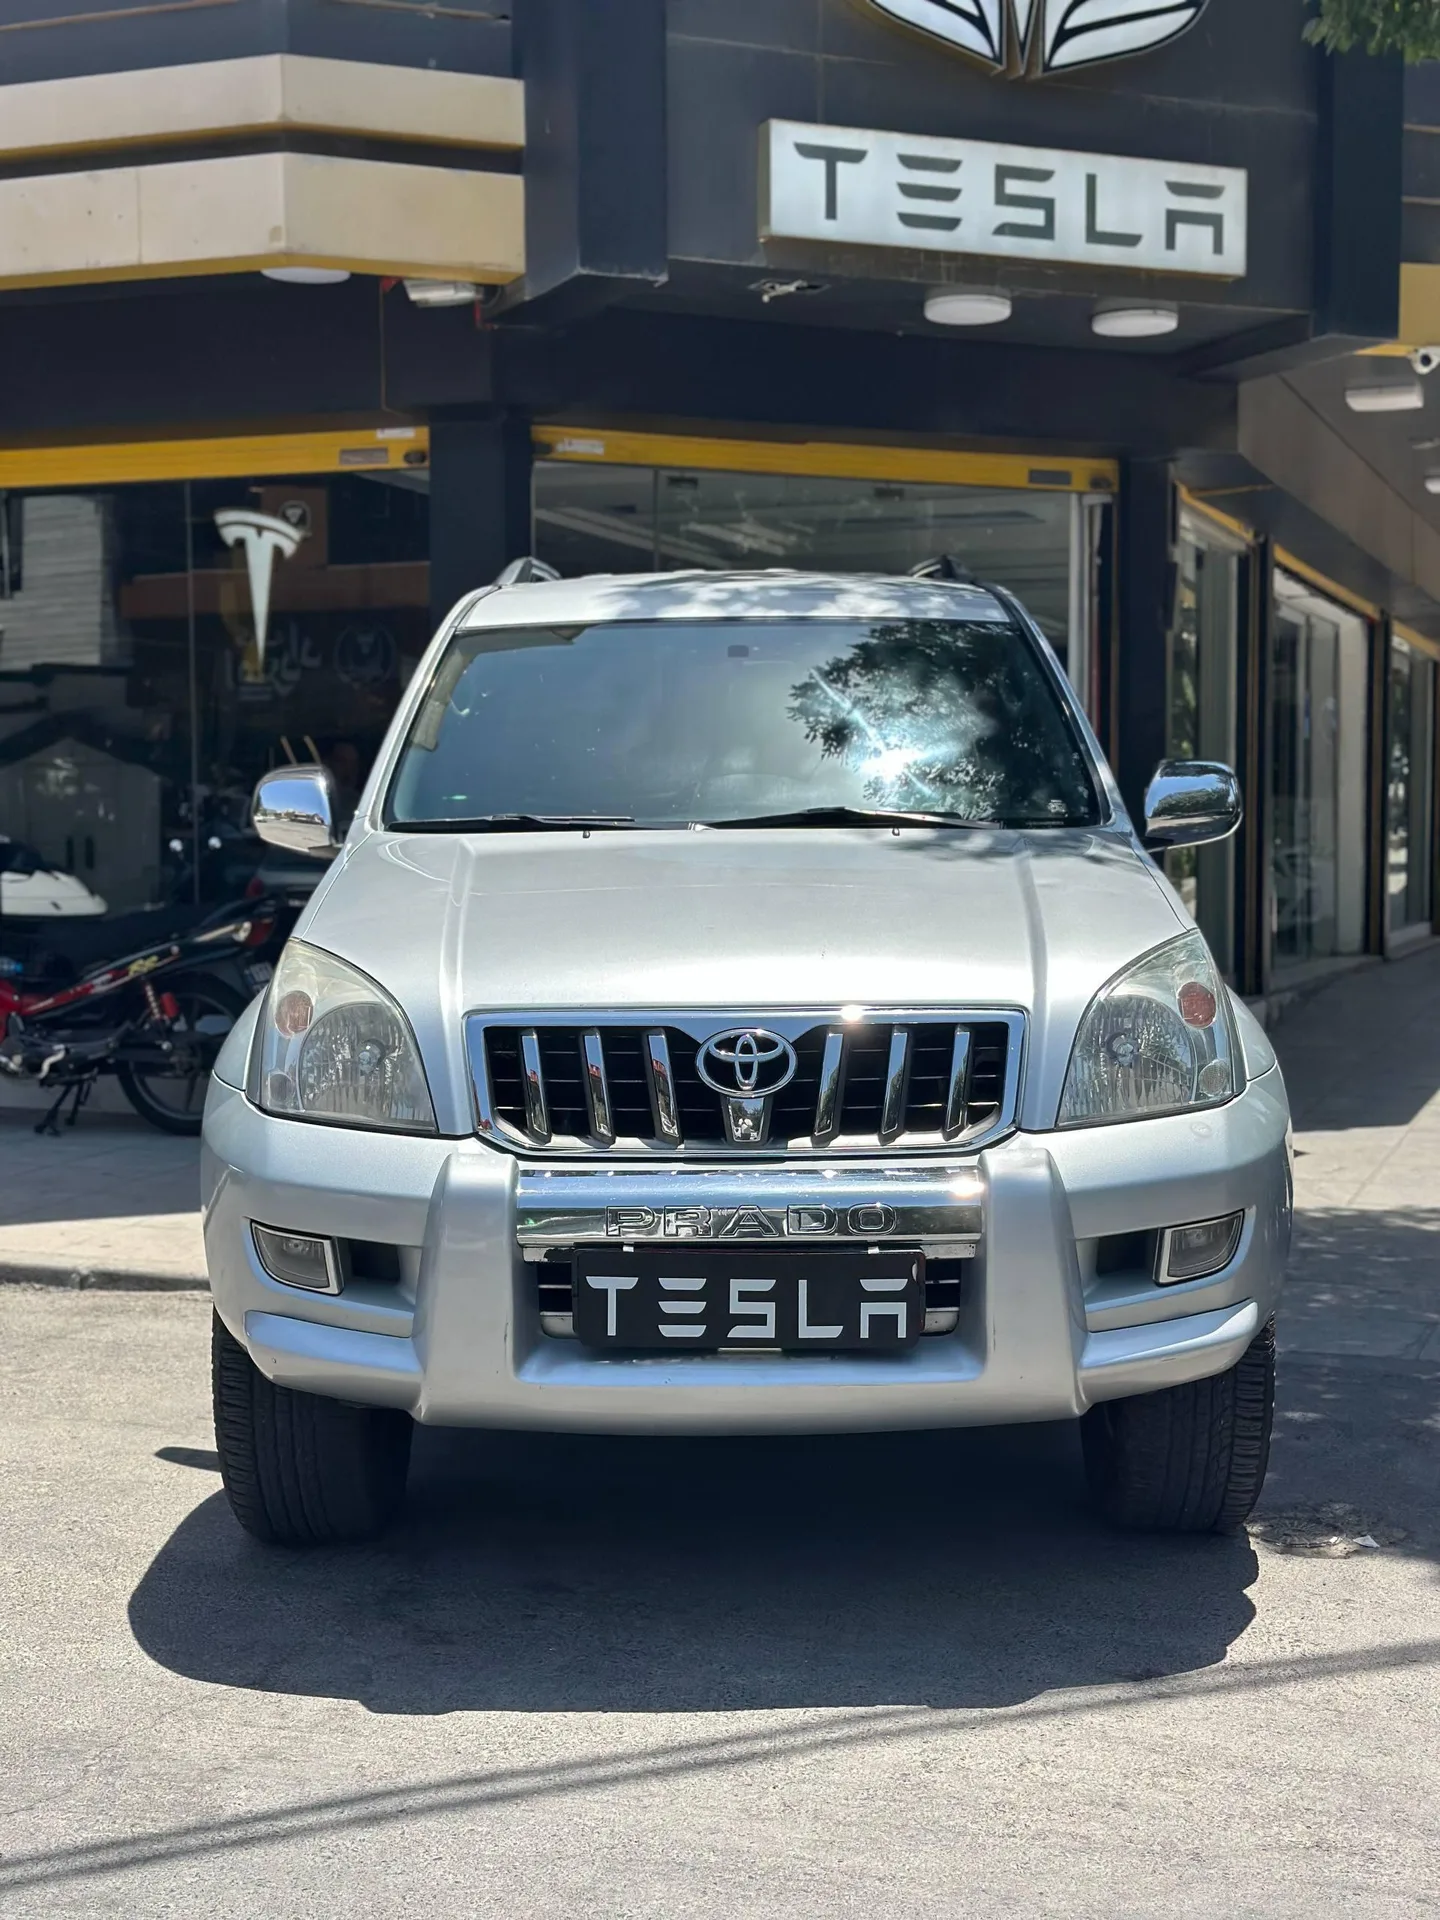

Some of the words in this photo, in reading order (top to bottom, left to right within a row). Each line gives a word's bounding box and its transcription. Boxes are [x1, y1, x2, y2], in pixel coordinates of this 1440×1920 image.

[793, 141, 1226, 255] TESLA
[605, 1203, 898, 1238] PRADO
[585, 1275, 908, 1339] TESLA
